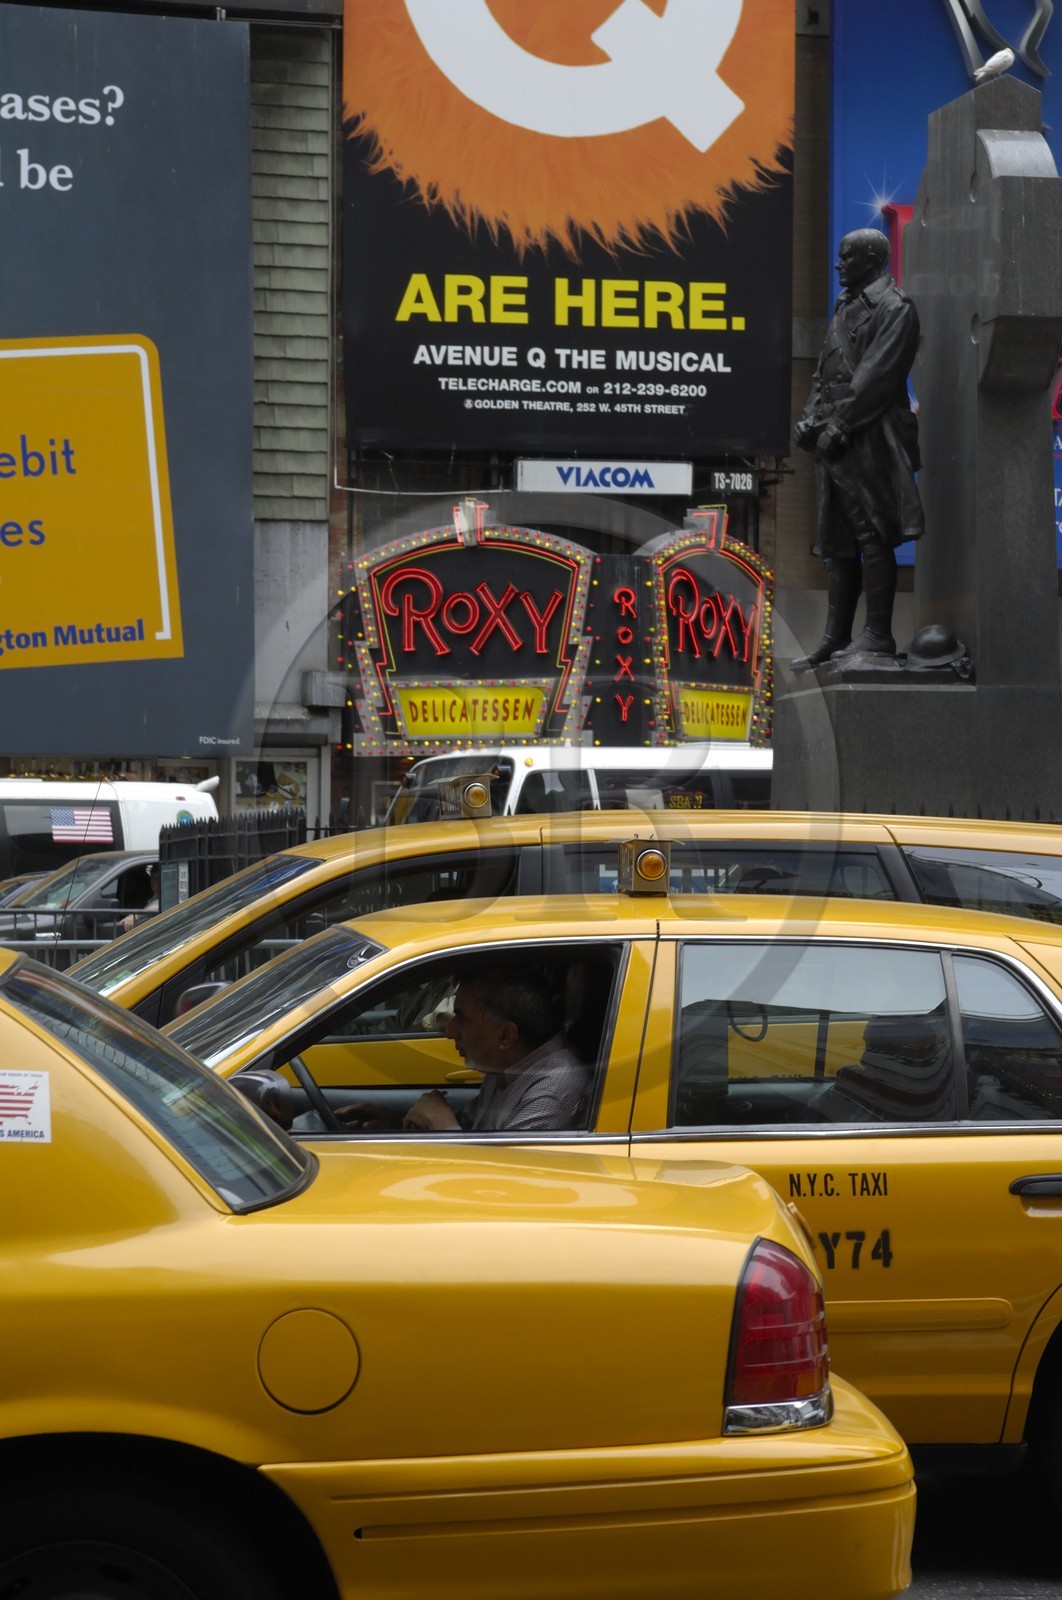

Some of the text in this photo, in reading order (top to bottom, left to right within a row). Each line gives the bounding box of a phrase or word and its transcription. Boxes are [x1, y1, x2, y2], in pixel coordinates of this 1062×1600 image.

[0, 85, 124, 126] ases?
[16, 148, 73, 191] be
[395, 273, 746, 331] ARE HERE.
[413, 344, 732, 373] AVENUE Q THE MUSICAL
[438, 377, 707, 397] TELECHARGE.COM OR 212-239-6200
[474, 400, 519, 410] GOLDEN
[522, 400, 574, 412] THEATRE,
[614, 404, 642, 414] 45TH
[644, 404, 686, 415] STREET
[556, 467, 655, 488] VIACOM
[714, 472, 753, 490] TS-7026
[0, 520, 46, 547] es
[381, 567, 563, 656] ROXY
[668, 568, 758, 662] ROXY
[54, 618, 145, 646] Mutual
[613, 587, 637, 722] ROXY
[408, 698, 535, 724] DELICATESSEN
[684, 702, 749, 727] DELICATESSEN
[199, 736, 217, 744] FDIC
[7, 1129, 45, 1139] AMERICA
[788, 1172, 888, 1197] N.Y.C. TAXI
[818, 1229, 893, 1269] Y74
